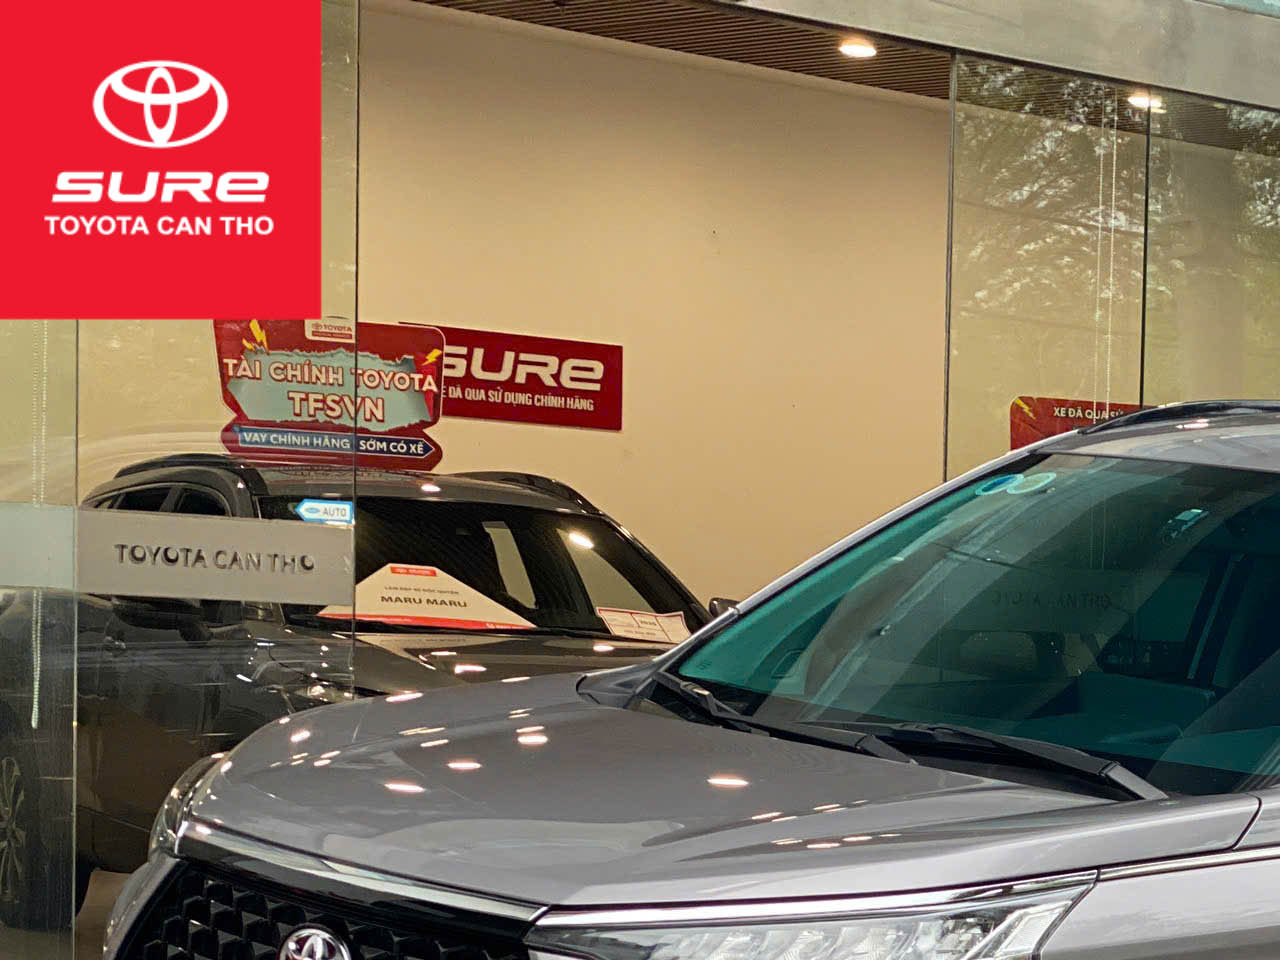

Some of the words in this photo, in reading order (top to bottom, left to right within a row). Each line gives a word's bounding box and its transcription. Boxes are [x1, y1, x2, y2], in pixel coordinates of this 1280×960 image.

[222, 355, 263, 380] TÀI
[267, 359, 345, 386] CHÍNH
[349, 366, 439, 394] TOYOTA
[443, 345, 605, 411] SURE
[287, 390, 386, 422] TFSVN
[464, 387, 487, 401] QUA
[533, 392, 566, 409] CHÍNH
[1053, 406, 1067, 417] XE
[1085, 408, 1109, 420] QUA
[243, 431, 269, 444] VAY
[269, 432, 312, 447] CHÍNH
[359, 438, 388, 452] SỚM
[389, 438, 407, 454] CÓ
[322, 507, 347, 518] AUTO
[114, 543, 208, 569] TOYOTA
[214, 550, 262, 571] CAN
[265, 553, 316, 574] THO
[380, 595, 423, 605] MARU
[426, 598, 468, 608] MARU
